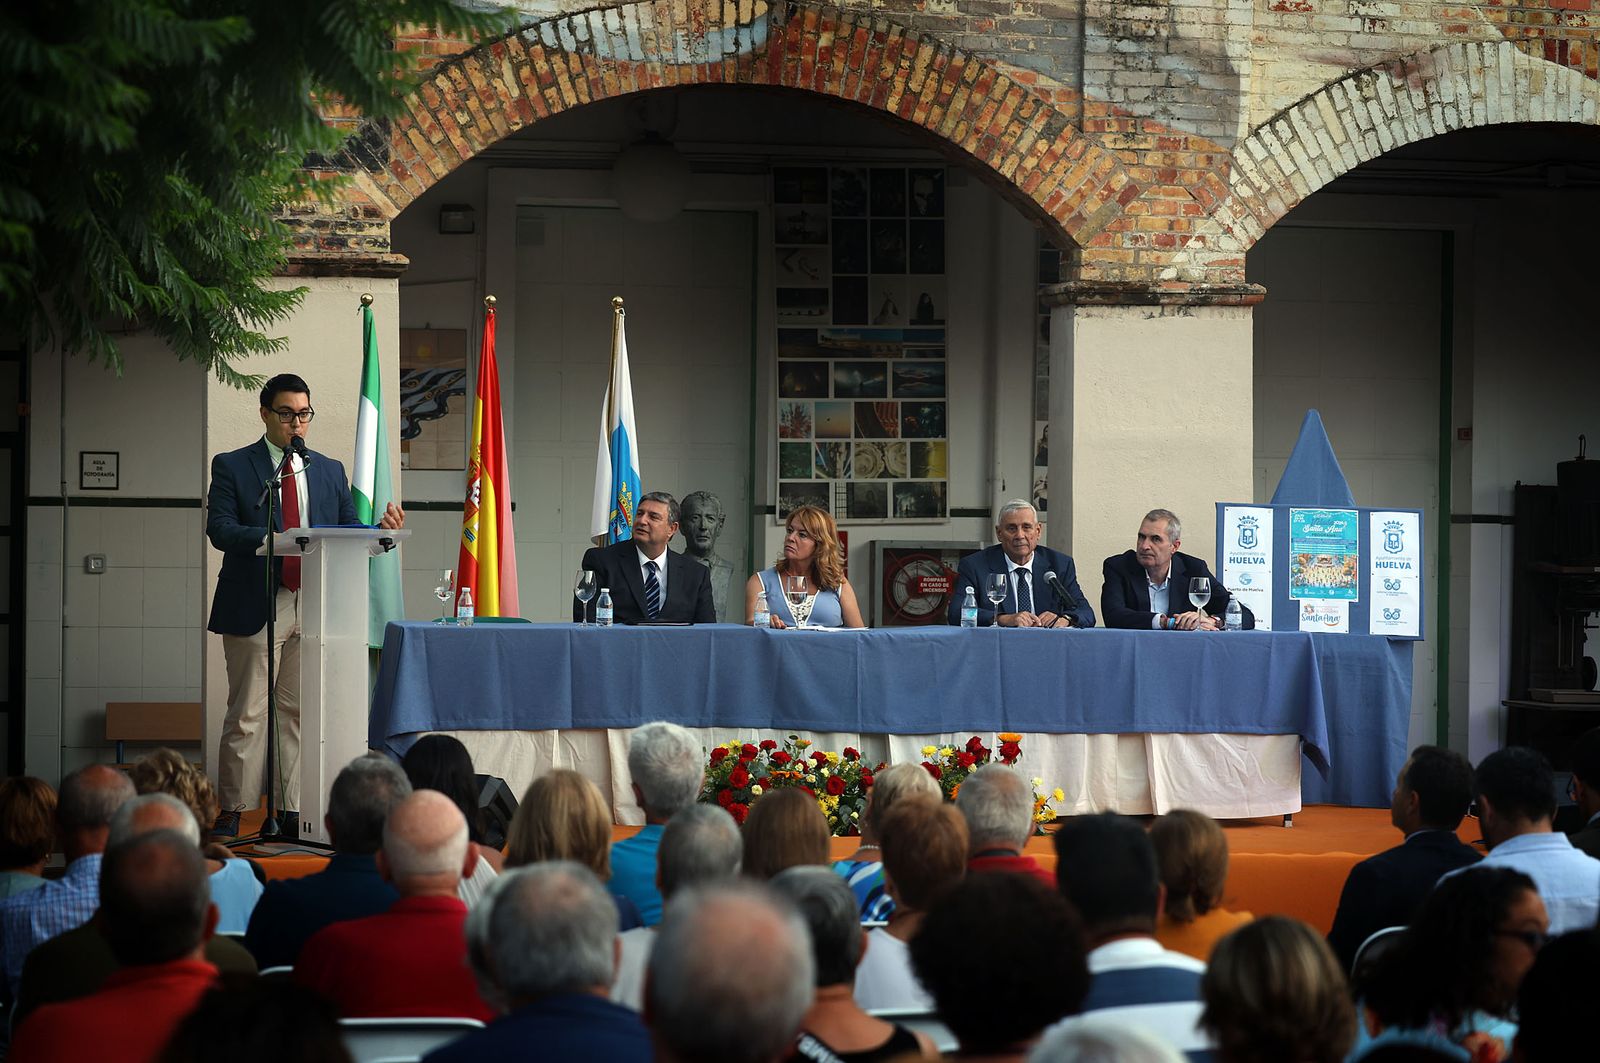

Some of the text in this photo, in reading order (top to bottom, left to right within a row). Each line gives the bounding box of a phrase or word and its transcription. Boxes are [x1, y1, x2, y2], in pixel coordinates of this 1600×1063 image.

[1303, 524, 1343, 533] Santa Ana
[1301, 613, 1323, 623] Santa
